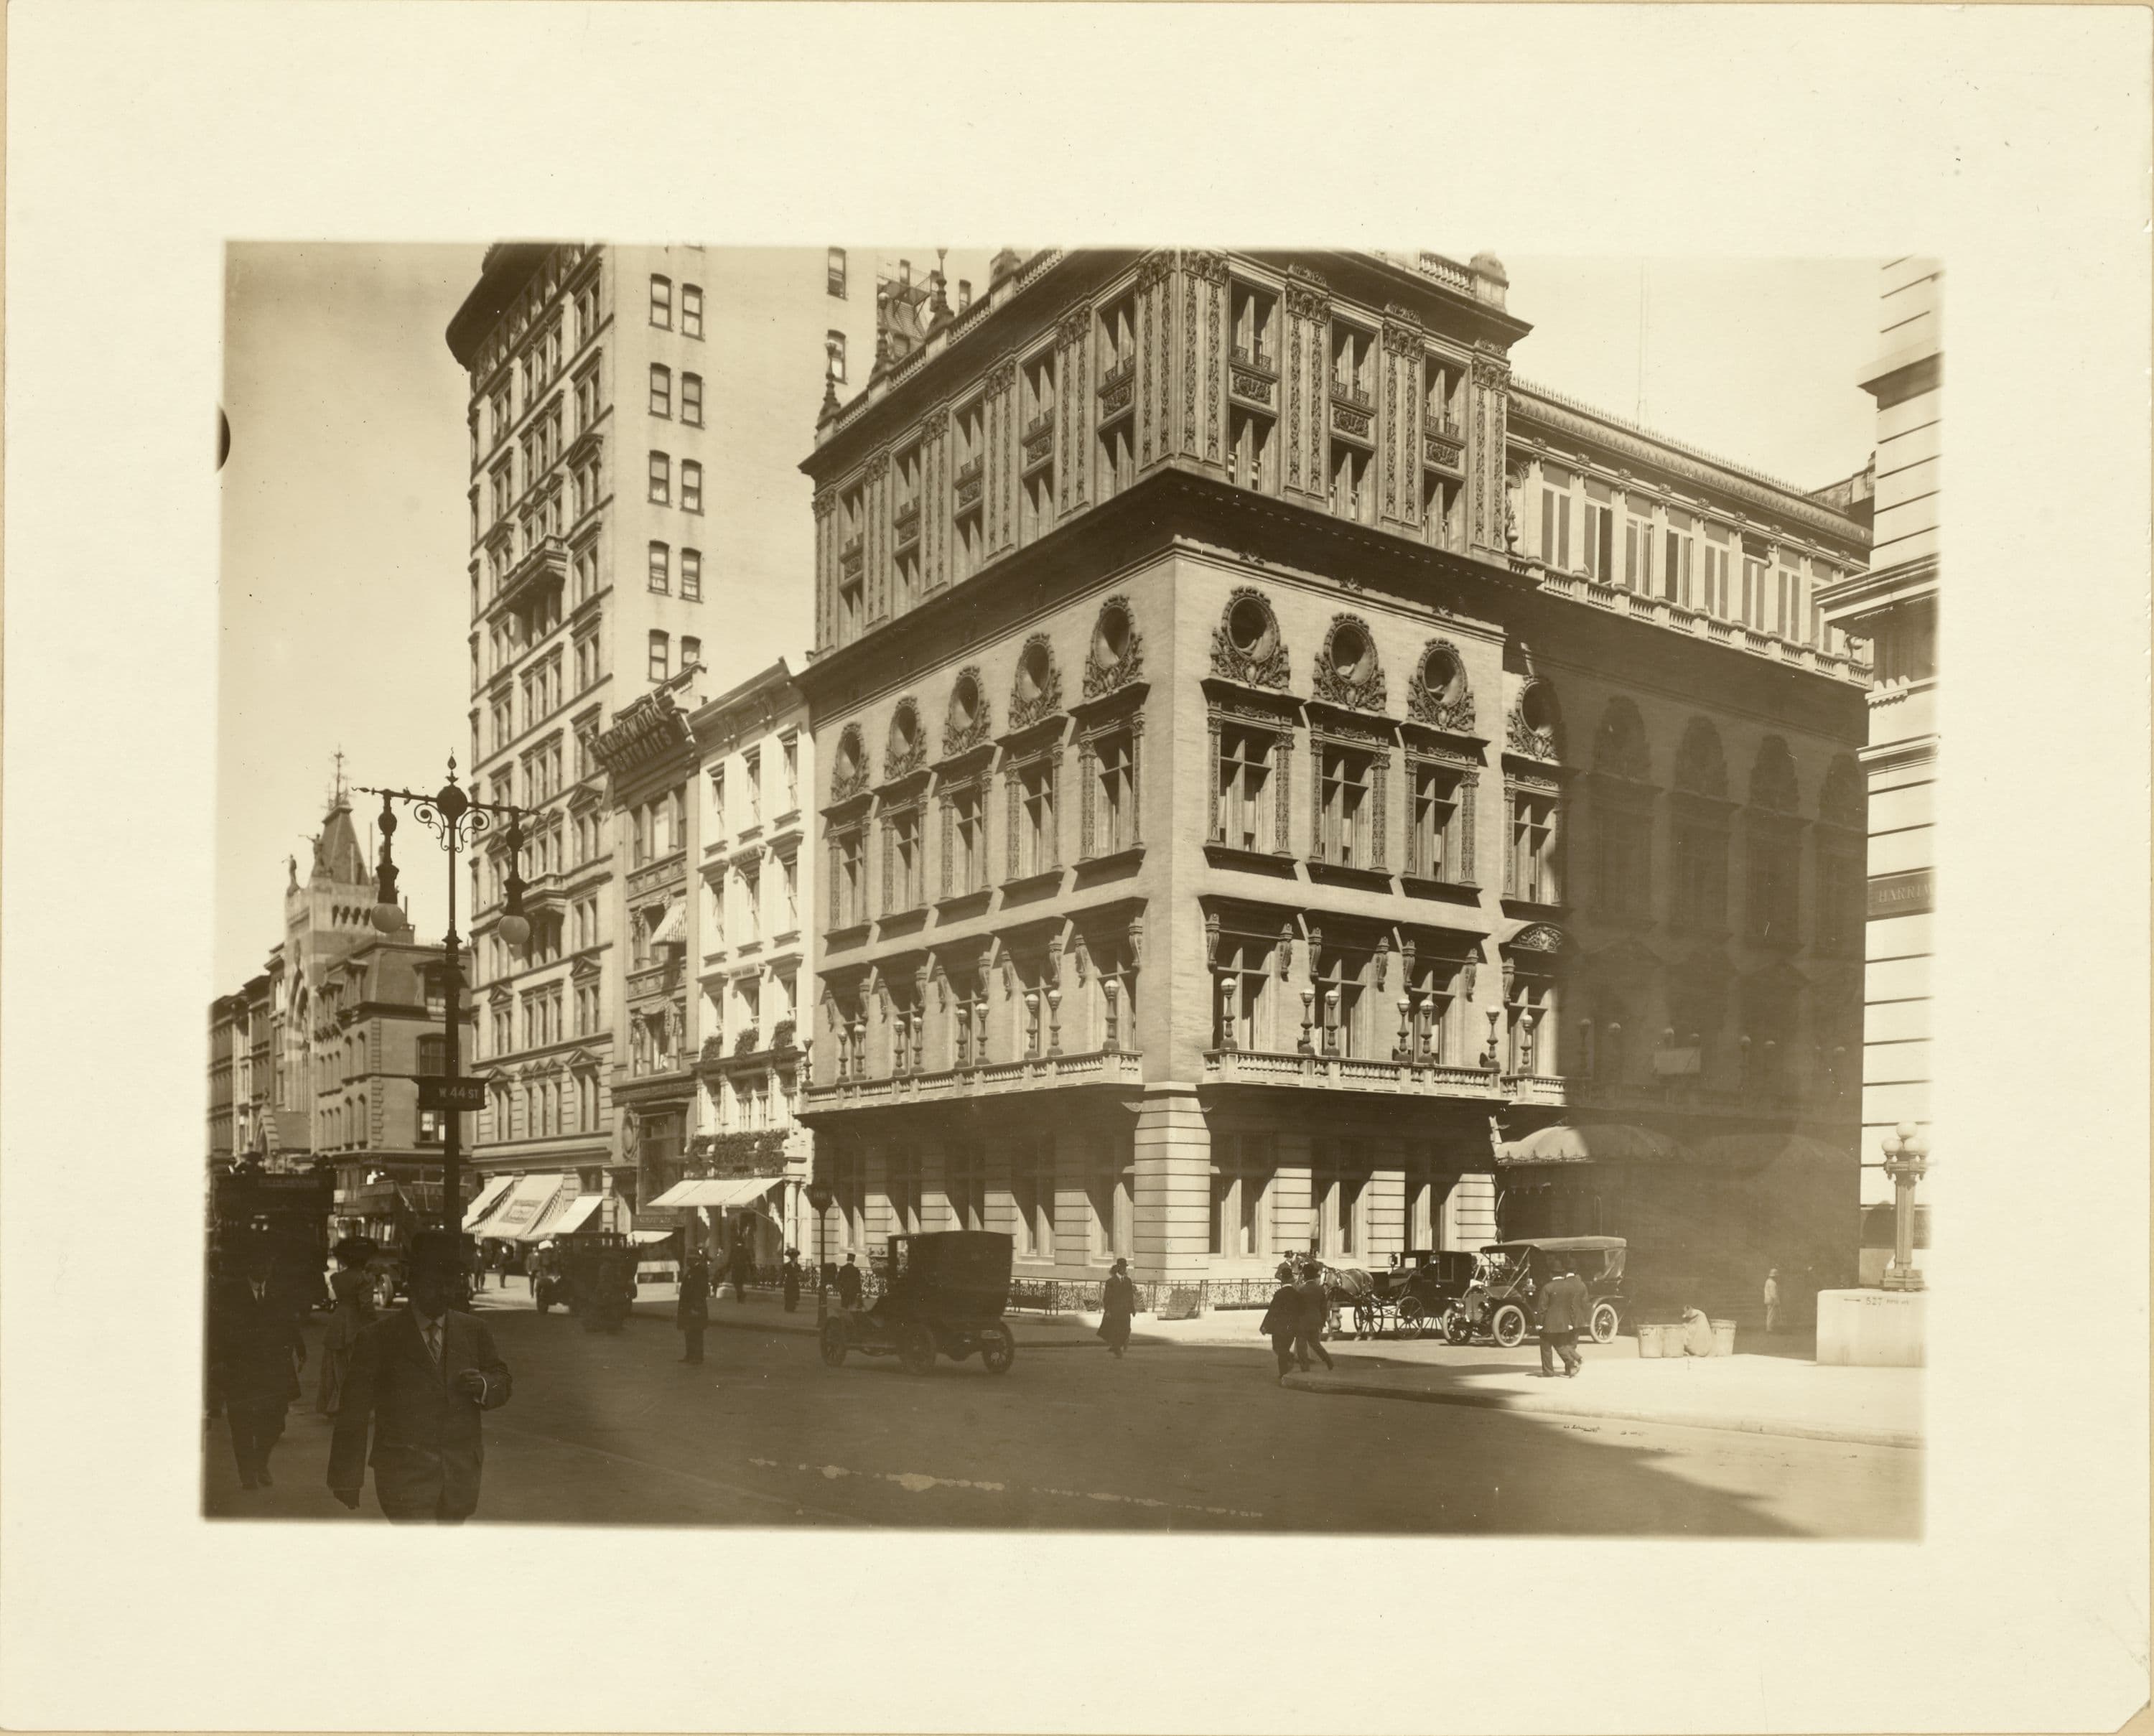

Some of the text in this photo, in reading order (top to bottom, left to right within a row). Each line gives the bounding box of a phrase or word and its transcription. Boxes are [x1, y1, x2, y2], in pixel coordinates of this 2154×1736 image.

[606, 726, 672, 775] PORTRAITS
[439, 1086, 480, 1099] W 44 ST
